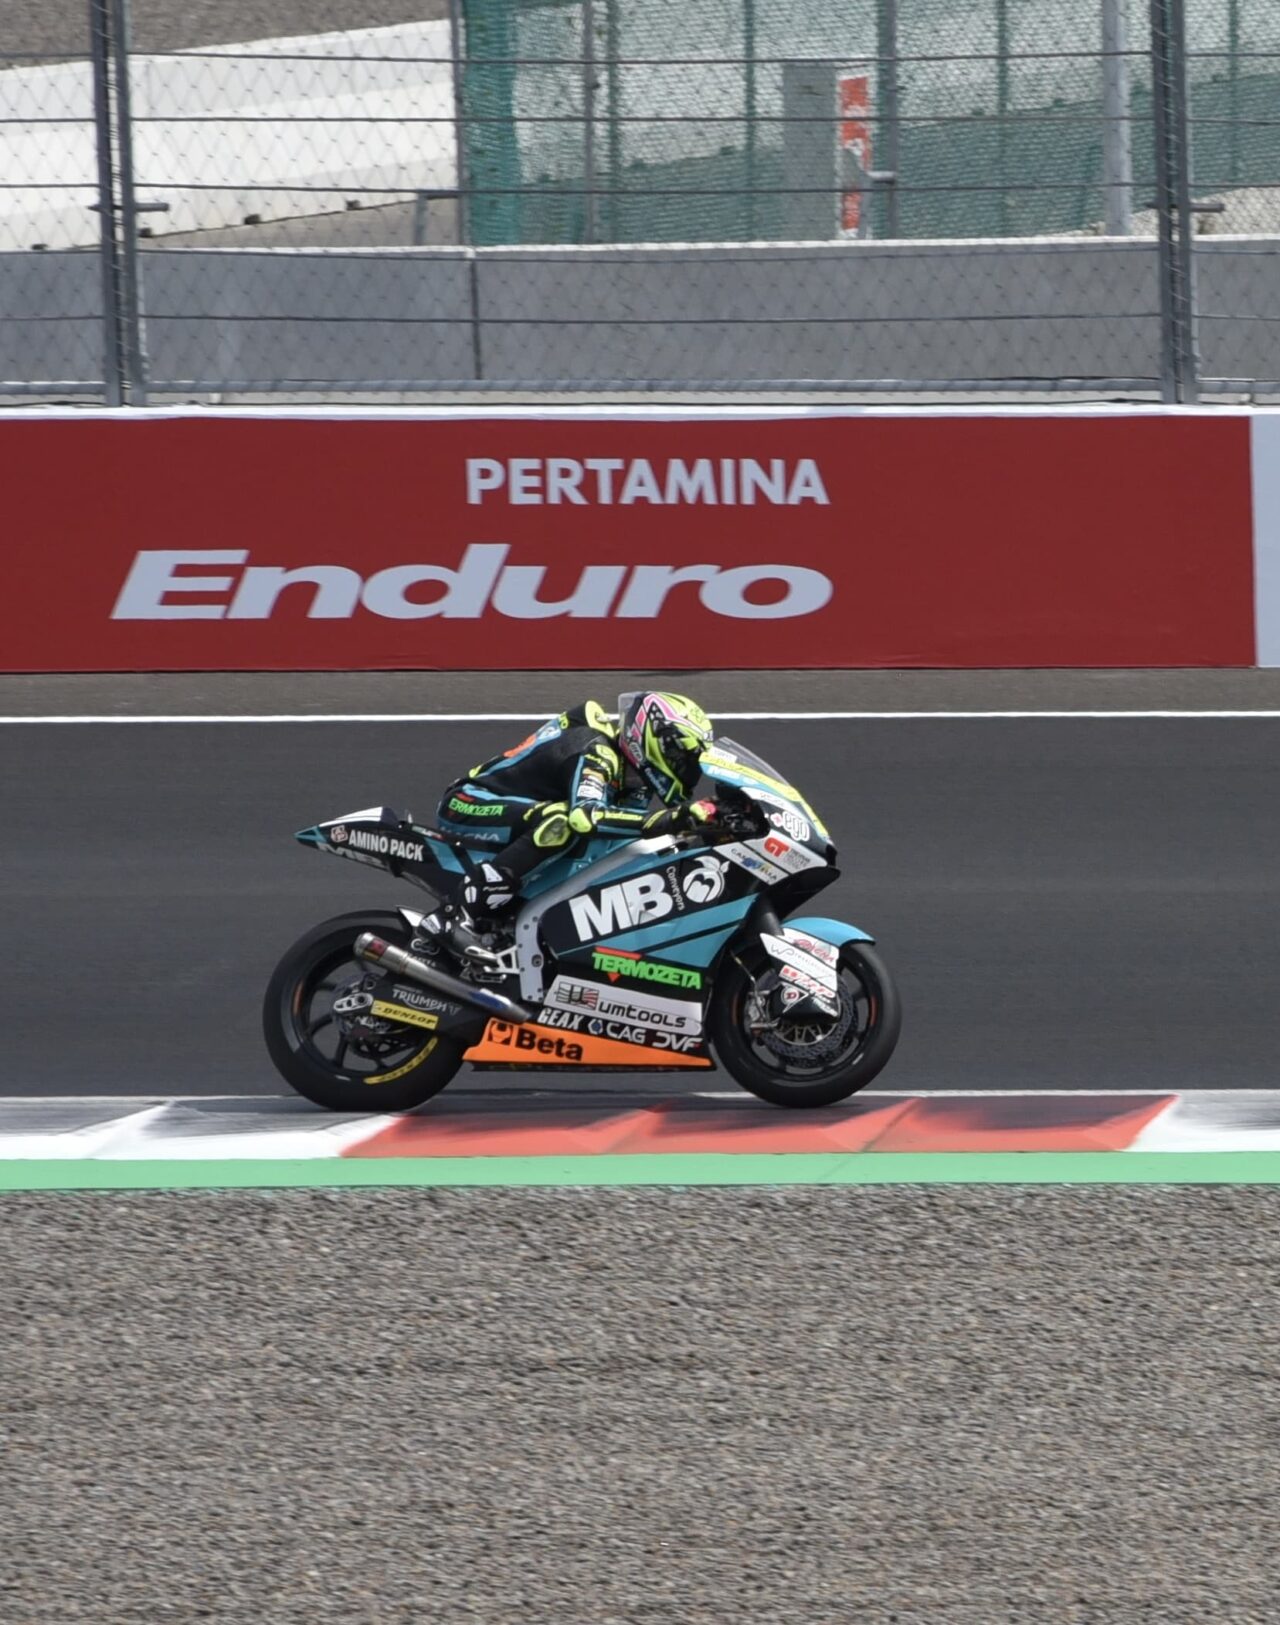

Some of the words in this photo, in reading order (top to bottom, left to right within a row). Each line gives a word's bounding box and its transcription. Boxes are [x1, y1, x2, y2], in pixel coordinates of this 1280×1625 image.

[467, 458, 829, 504] PERTAMINA
[111, 544, 832, 620] Enduro
[348, 829, 389, 853] AMINO
[389, 839, 424, 861] PACK
[666, 866, 686, 911] Conveyors
[568, 873, 673, 942] MB
[592, 952, 702, 990] TERMOZETA
[382, 1006, 436, 1025] DUNLOP
[392, 988, 448, 1012] TRIUMPH
[537, 1007, 584, 1030] GEAX
[606, 1022, 646, 1044] CAG
[515, 1028, 584, 1061] Beta
